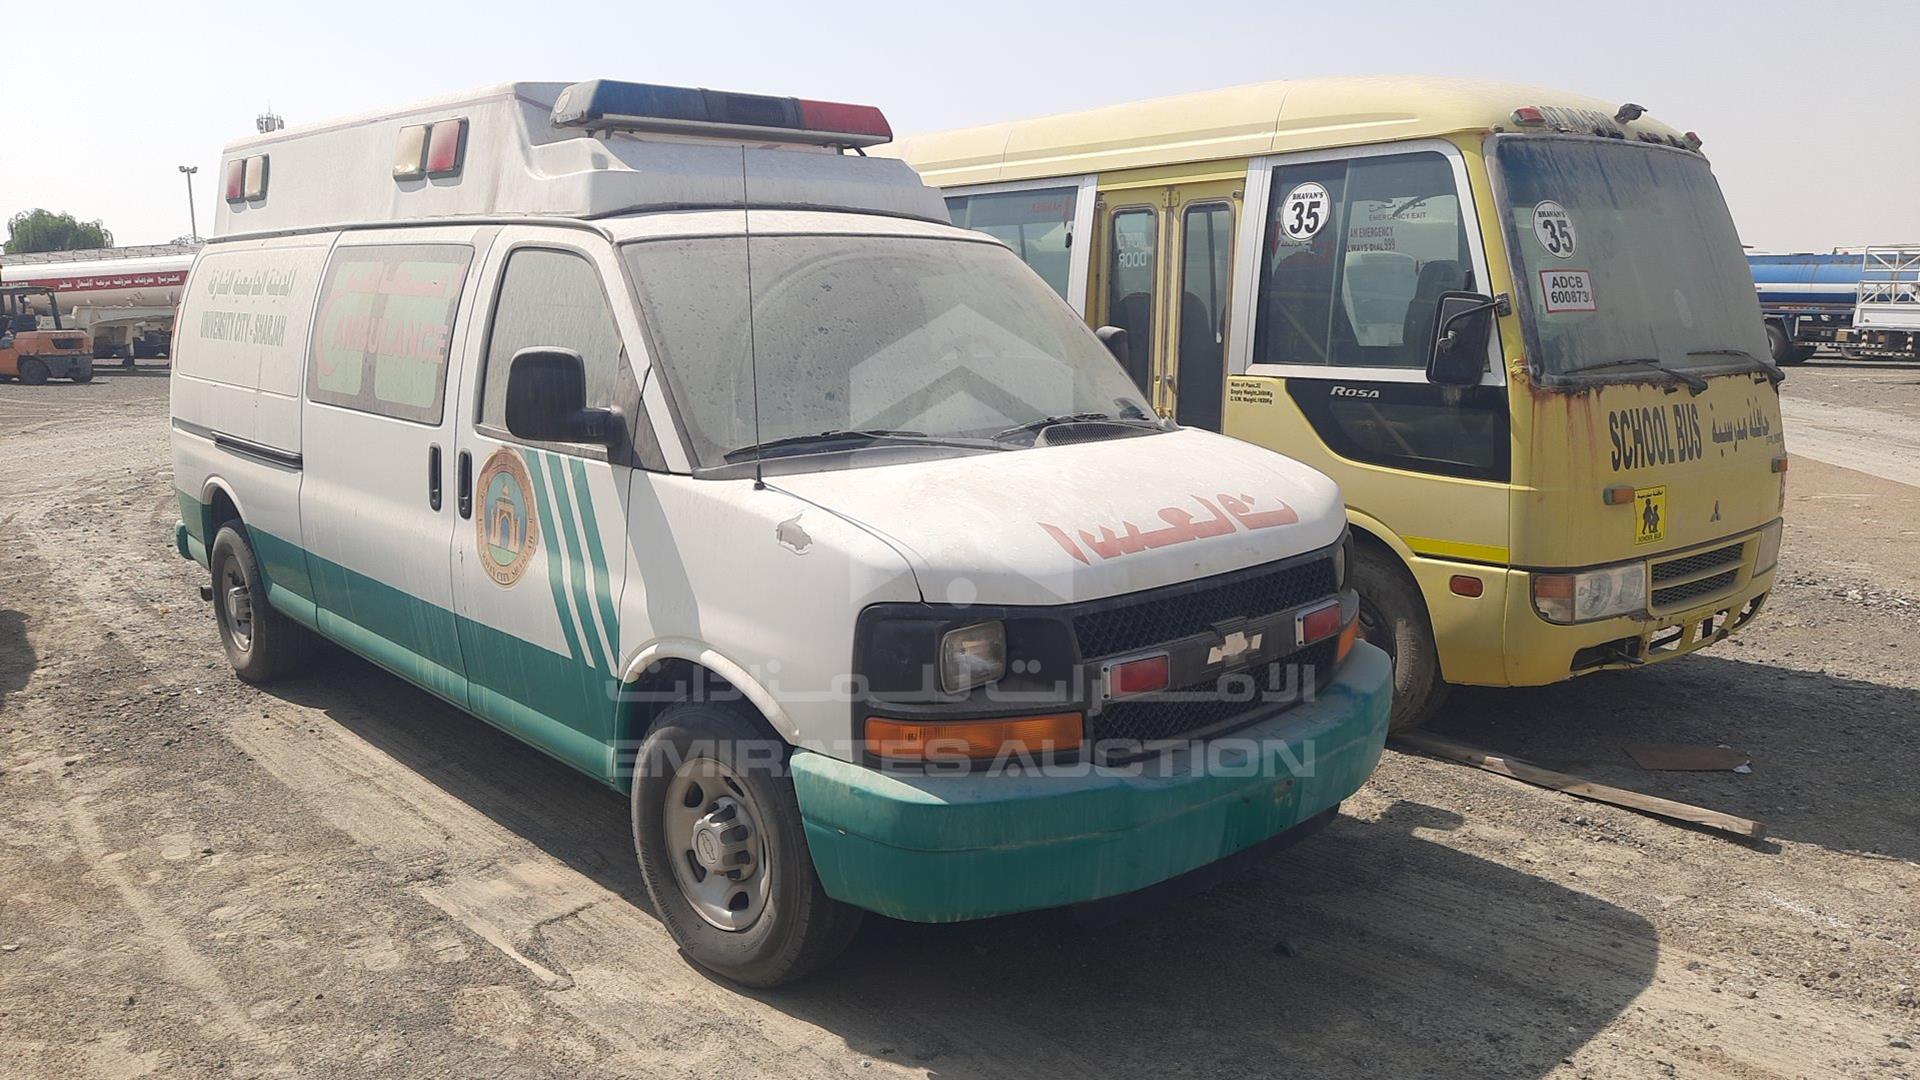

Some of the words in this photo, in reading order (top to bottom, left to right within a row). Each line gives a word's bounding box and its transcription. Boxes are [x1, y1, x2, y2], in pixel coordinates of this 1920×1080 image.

[1292, 191, 1323, 201] BHAVAN'S
[1289, 201, 1321, 235] 35
[1543, 219, 1573, 253] 35
[1551, 276, 1583, 289] ADCB
[200, 311, 235, 341] UNIVERSITY
[235, 312, 251, 342] CITY
[253, 313, 287, 347] SHARJAH
[334, 315, 449, 364] AMBULANCE
[1609, 405, 1675, 472] SCHOOL
[1673, 403, 1702, 463] BUS
